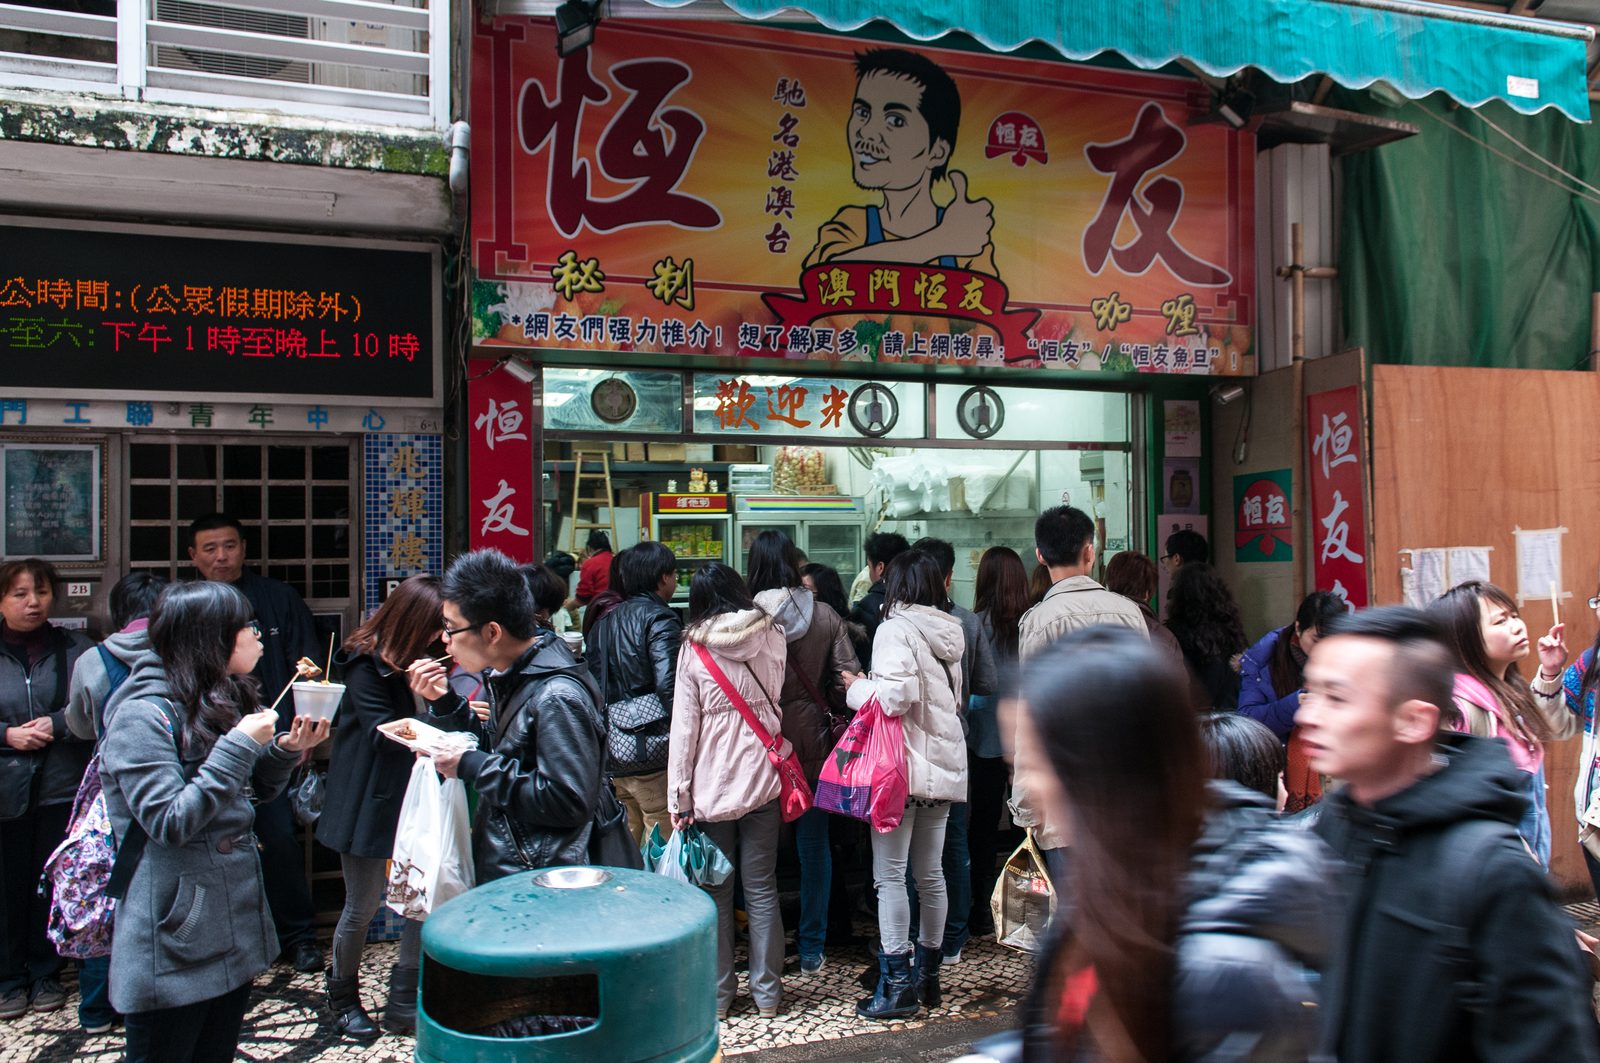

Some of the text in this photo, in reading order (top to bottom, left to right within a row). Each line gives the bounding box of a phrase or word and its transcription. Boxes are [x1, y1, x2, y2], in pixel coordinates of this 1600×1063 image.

[764, 76, 806, 254] 馳名港澳台
[352, 332, 379, 357] 10
[1243, 494, 1286, 526] 恒友
[71, 585, 88, 594] 2B
